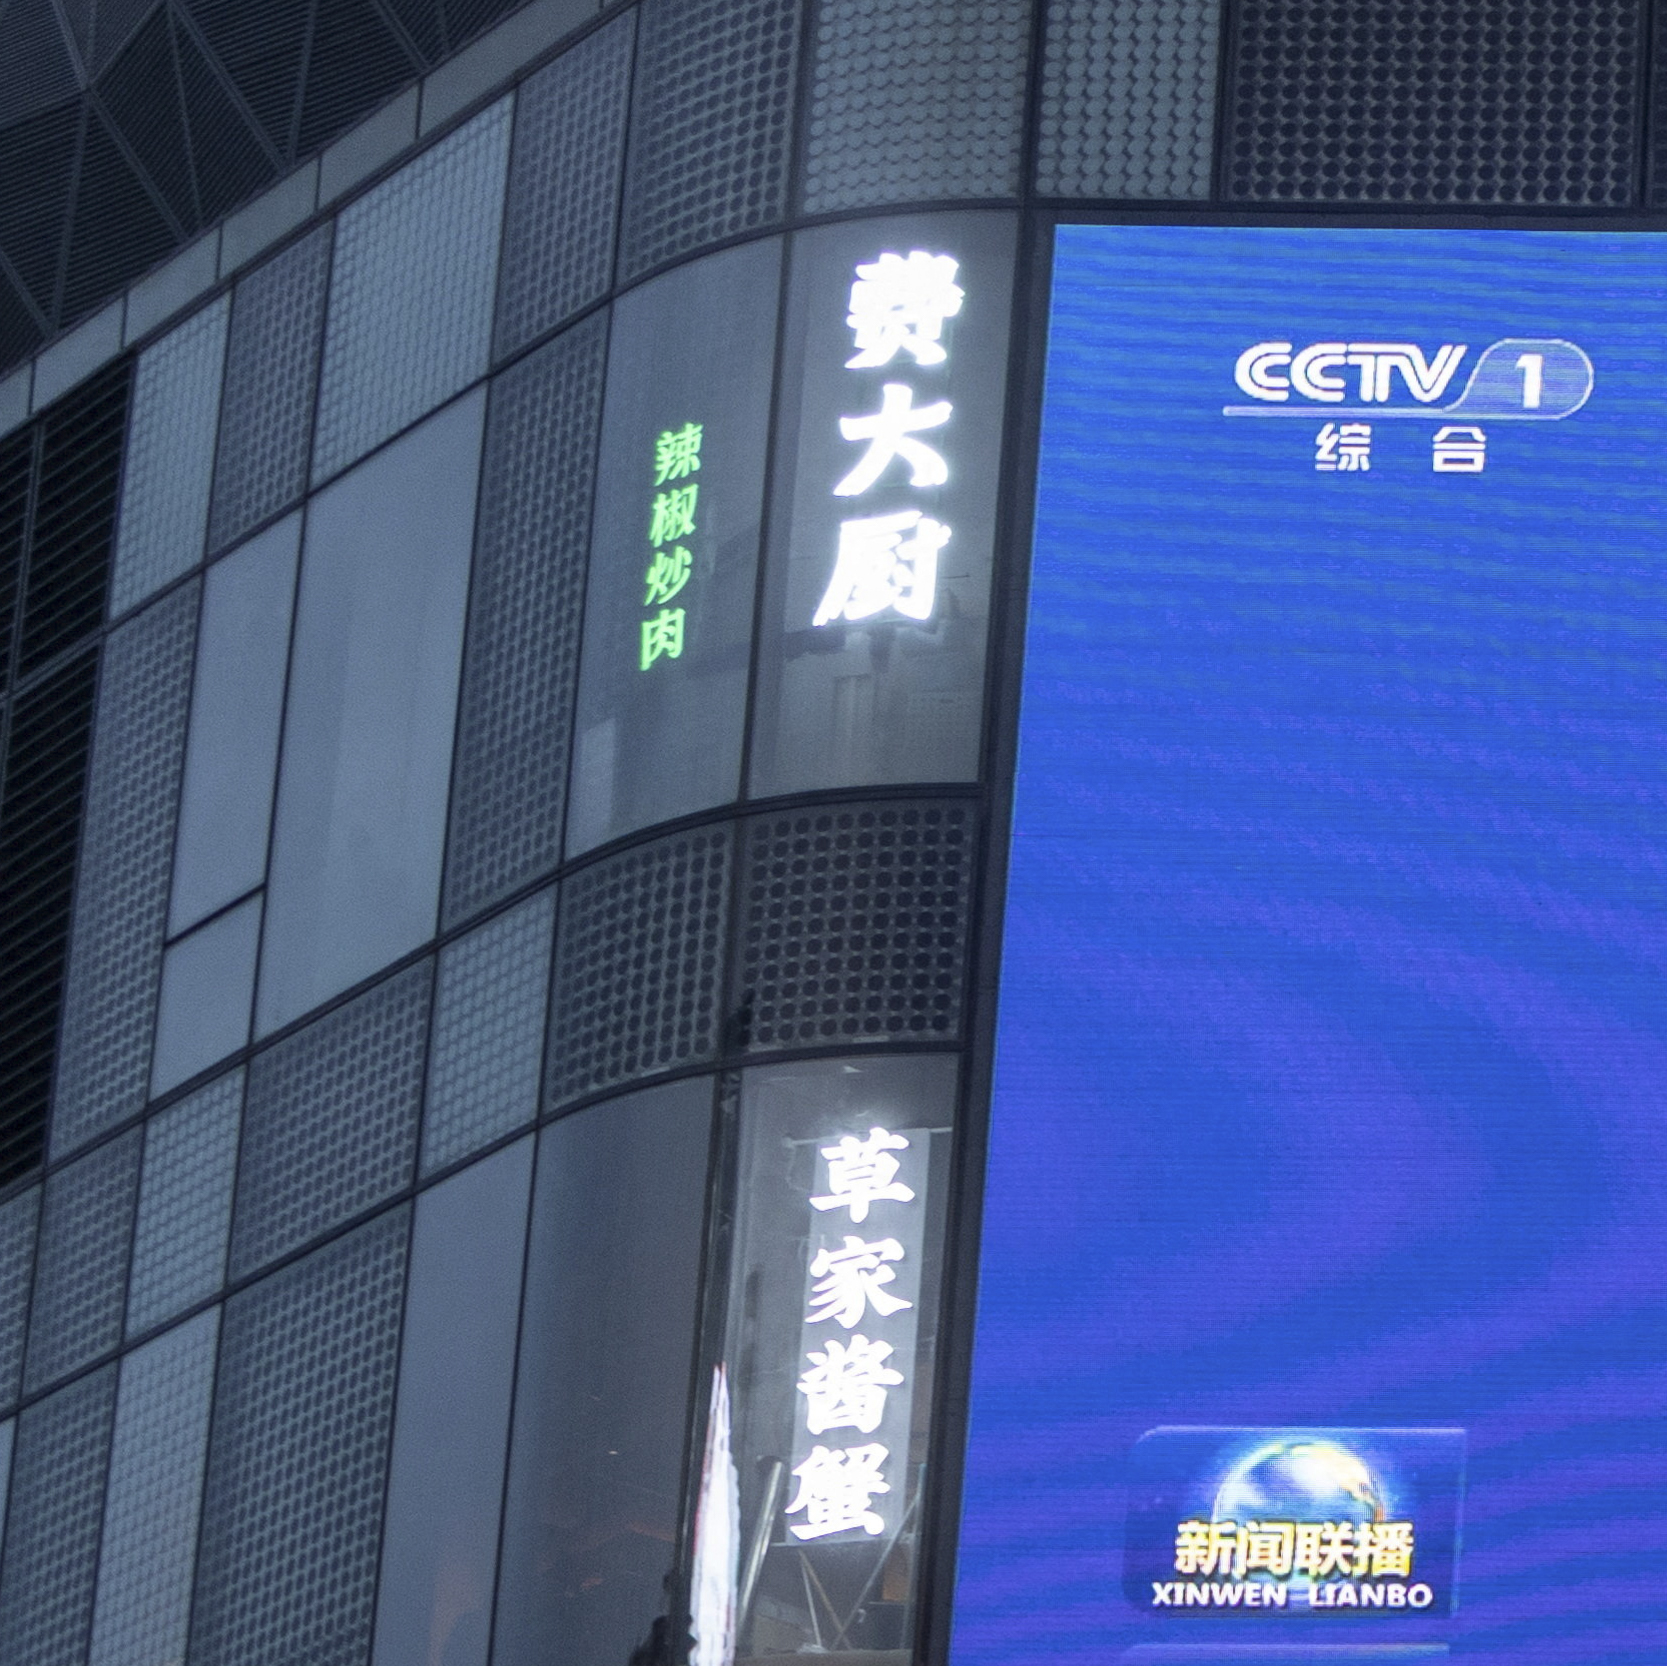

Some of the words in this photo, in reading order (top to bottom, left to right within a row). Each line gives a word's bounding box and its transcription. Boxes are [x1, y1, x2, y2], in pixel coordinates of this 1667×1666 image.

[1235, 342, 1468, 403] CCTV
[1516, 354, 1544, 408] 1
[812, 250, 966, 627] 费大厨
[1315, 423, 1486, 473] 综合
[640, 422, 703, 671] 辣椒炒肉
[784, 1126, 915, 1541] 草家酱蟹
[1175, 1520, 1414, 1578] 新闻联播
[1151, 1581, 1289, 1607] XINWEN
[1308, 1582, 1434, 1609] LIANBO
